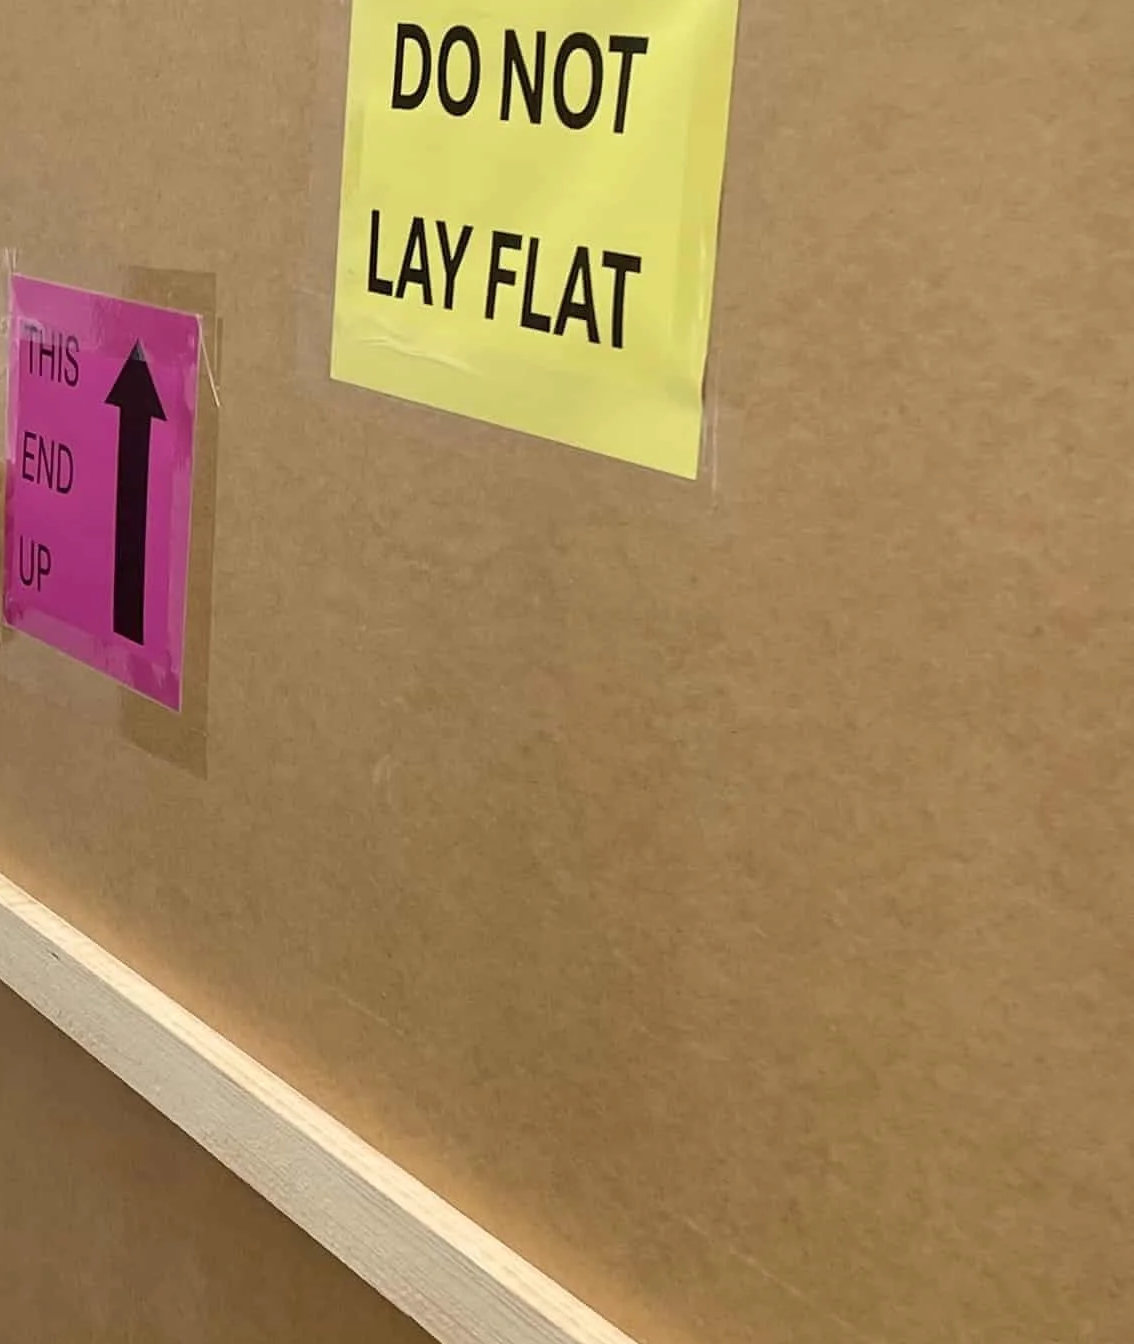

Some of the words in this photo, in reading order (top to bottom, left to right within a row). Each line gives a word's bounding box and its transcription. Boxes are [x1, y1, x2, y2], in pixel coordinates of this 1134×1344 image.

[391, 22, 481, 117] DO
[499, 28, 649, 134] NOT
[367, 209, 474, 310] LAY
[484, 230, 642, 349] FLAT
[23, 324, 80, 388] THIS
[21, 431, 74, 495] END
[18, 535, 52, 592] UP
